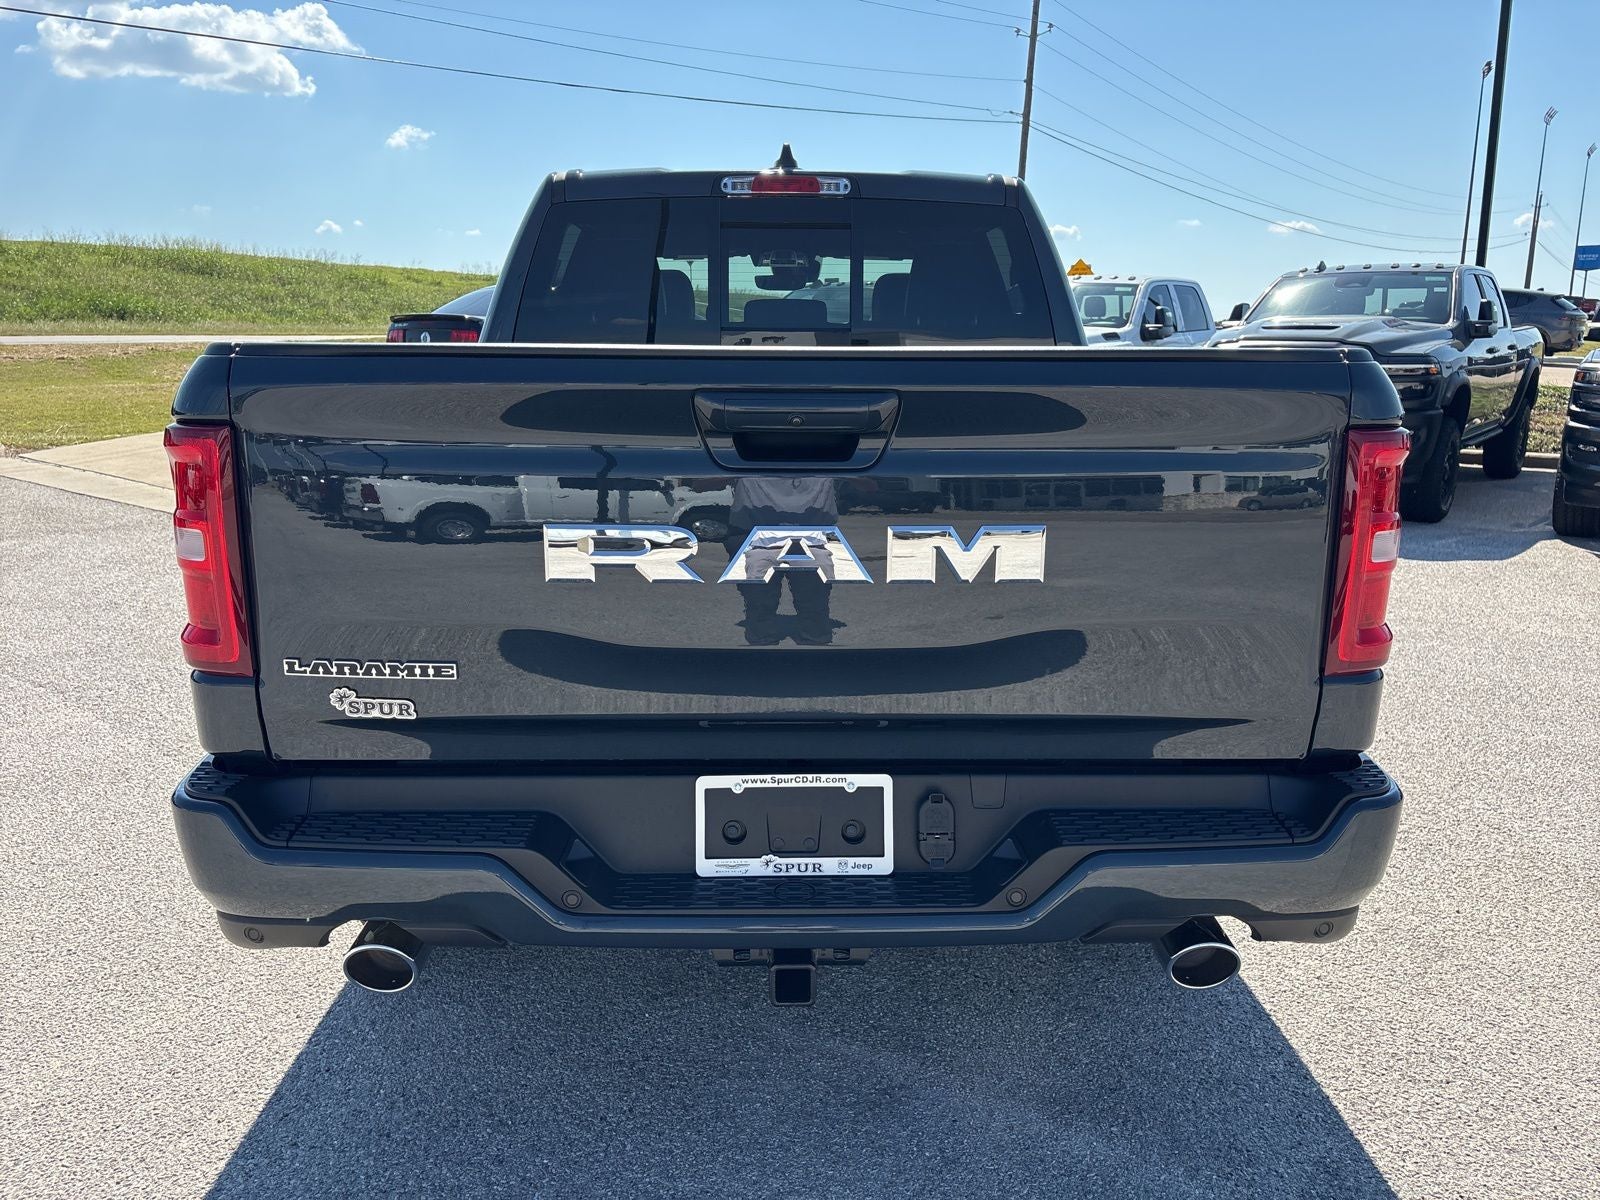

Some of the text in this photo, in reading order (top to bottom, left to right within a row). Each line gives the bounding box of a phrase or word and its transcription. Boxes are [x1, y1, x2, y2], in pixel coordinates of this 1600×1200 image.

[543, 524, 1046, 583] RAM
[283, 659, 457, 680] LARAMIE
[348, 701, 413, 716] SPUR
[741, 775, 847, 785] www.SpurCDJR.com
[773, 862, 824, 873] SPUR
[850, 861, 873, 871] Jeep
